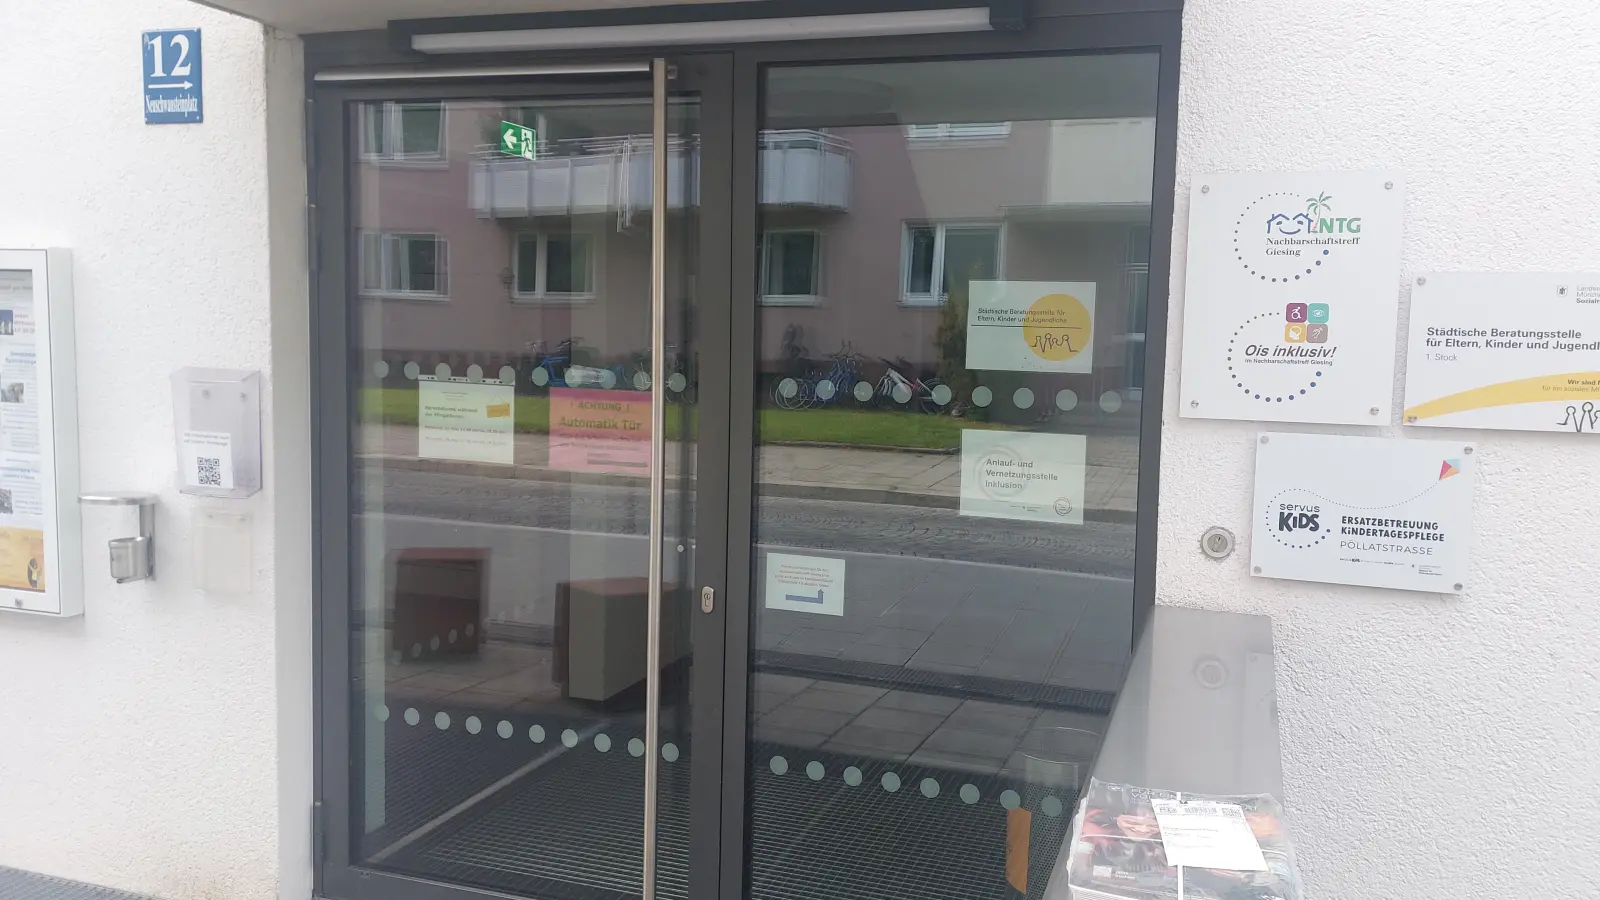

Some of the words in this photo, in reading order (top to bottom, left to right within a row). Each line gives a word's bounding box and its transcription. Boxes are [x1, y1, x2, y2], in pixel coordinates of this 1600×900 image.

[148, 34, 191, 77] 12
[1320, 217, 1361, 234] NTG
[1266, 236, 1360, 246] Nachbarschaftstreff
[1266, 247, 1302, 256] Giesing
[978, 307, 1008, 315] Städtische
[1010, 308, 1055, 317] Beratungsstelle
[1427, 326, 1487, 337] Städtische
[1490, 328, 1582, 340] Beratungsstelle
[1426, 339, 1442, 348] für
[1445, 339, 1482, 349] Eltern,
[1485, 340, 1523, 349] Kinder
[1526, 341, 1549, 350] und
[1245, 344, 1270, 357] Ois
[1272, 345, 1337, 358] inklusiv!
[578, 401, 622, 411] ACHTUNG
[560, 416, 618, 430] Automatik
[621, 419, 643, 430] Tür
[986, 458, 1016, 467] Anlauf-
[986, 469, 1058, 481] Vernetzungsstelle
[985, 480, 1022, 489] Inklusion
[1280, 503, 1320, 513] servus
[1341, 516, 1439, 530] ERSATZBETREUUNG
